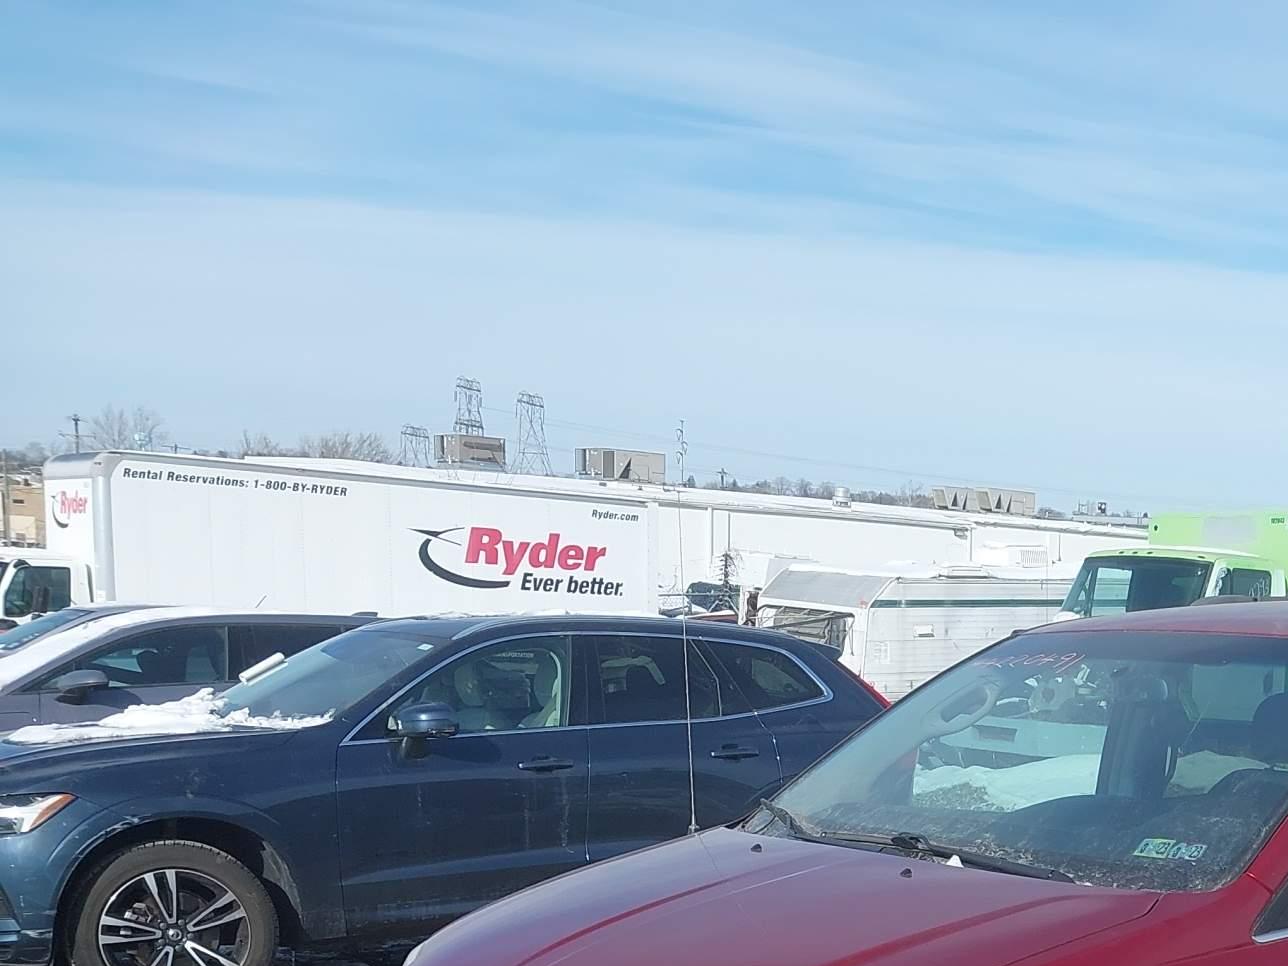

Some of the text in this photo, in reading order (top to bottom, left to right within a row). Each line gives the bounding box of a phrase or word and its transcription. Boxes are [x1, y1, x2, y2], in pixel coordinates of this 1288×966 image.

[122, 467, 348, 497] Rental Reservations: 1-800-BY-RYDER
[60, 490, 88, 520] Ryder
[591, 508, 640, 523] Ryder.com
[464, 526, 607, 576] Ryder
[520, 572, 624, 597] Ever better.
